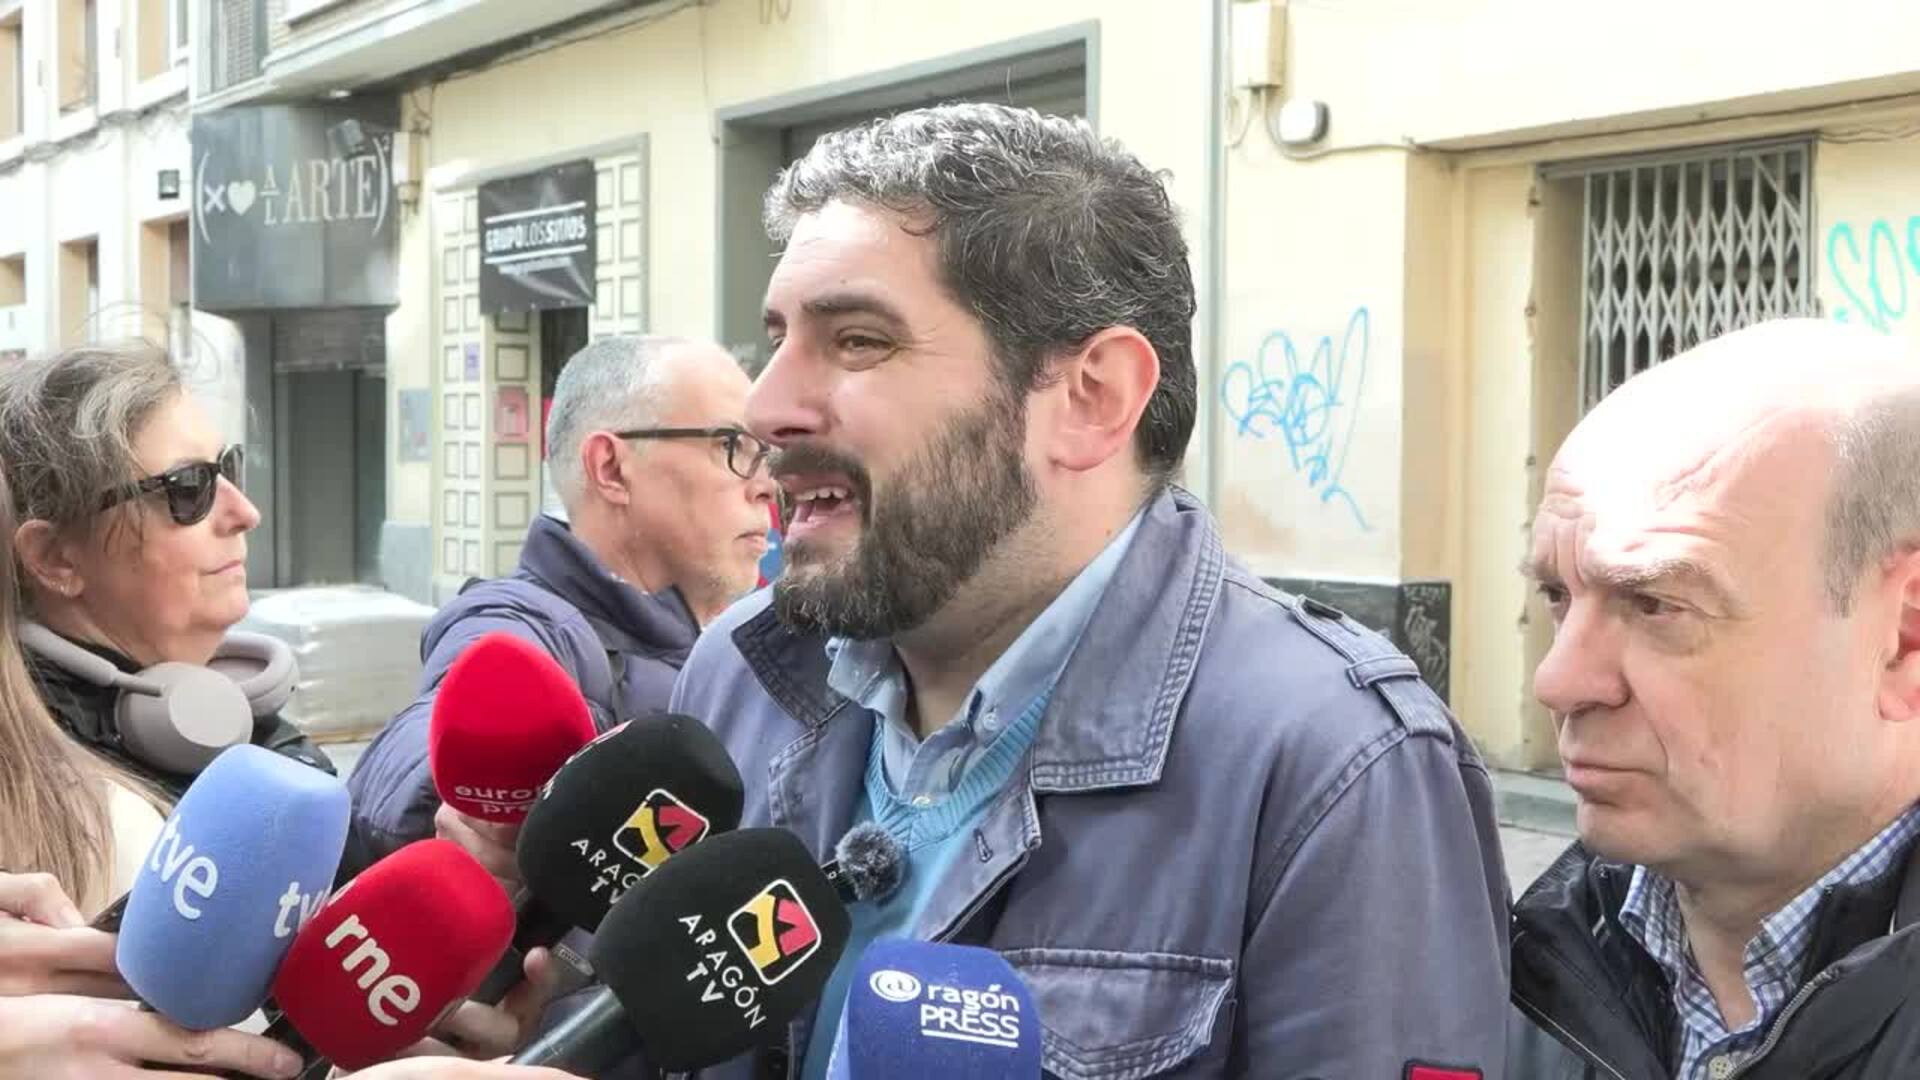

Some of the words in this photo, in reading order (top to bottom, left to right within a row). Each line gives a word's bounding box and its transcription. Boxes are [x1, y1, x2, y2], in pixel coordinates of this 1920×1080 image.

[151, 813, 218, 920] tve
[571, 839, 642, 889] ARAG
[274, 882, 332, 938] tv
[325, 914, 421, 1026] rne
[678, 914, 767, 1029] ARAGÓN
[686, 962, 725, 1004] TV
[920, 1004, 1021, 1040] PRESS
